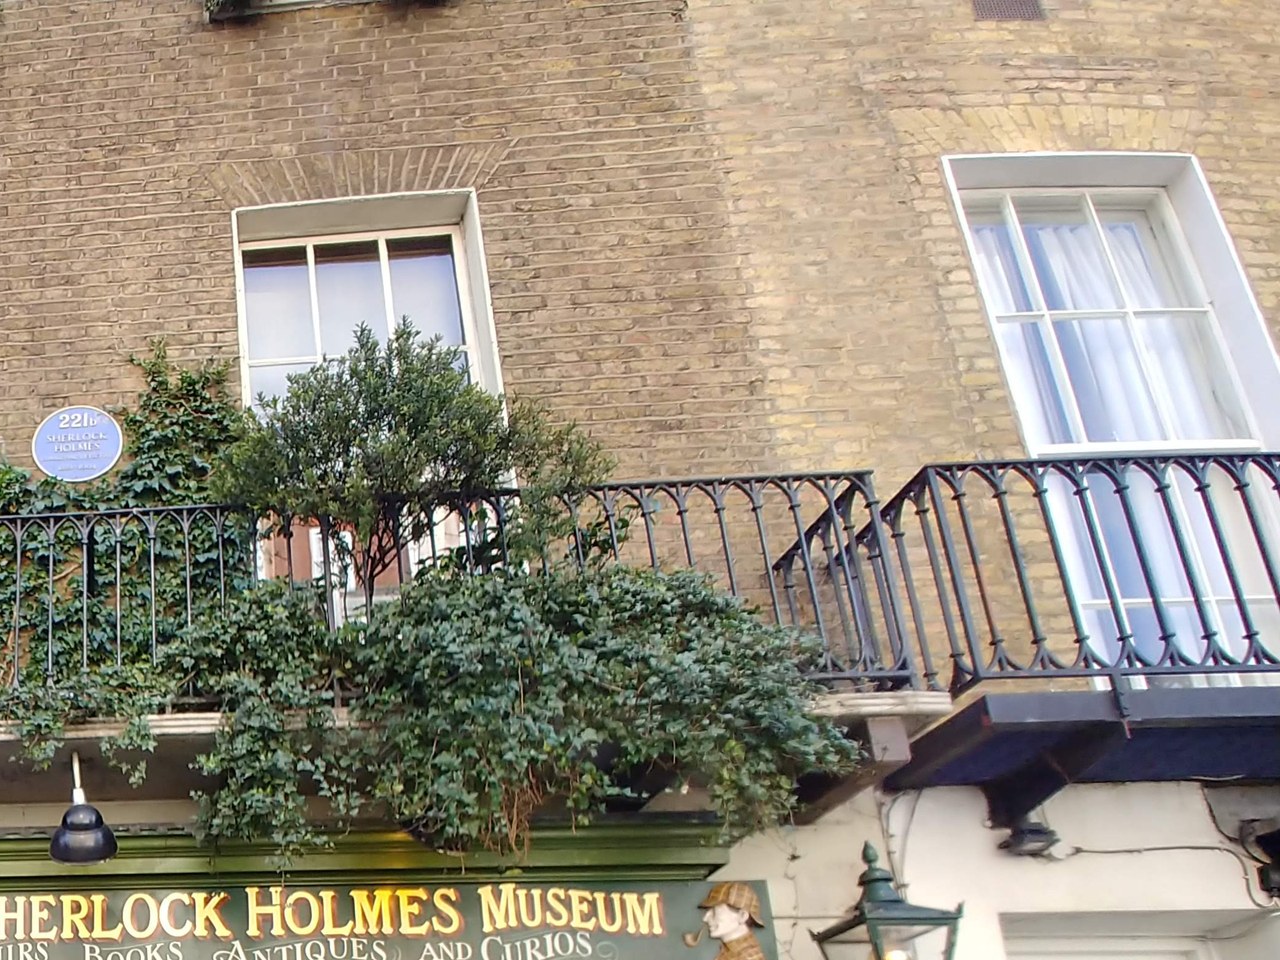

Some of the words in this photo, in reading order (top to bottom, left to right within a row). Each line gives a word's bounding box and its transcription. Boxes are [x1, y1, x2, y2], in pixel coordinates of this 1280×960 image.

[59, 412, 97, 429] 221b
[47, 432, 107, 442] SHERLOCK
[54, 442, 101, 452] HOLMES
[244, 886, 462, 937] HOLMES
[477, 883, 664, 935] MUSEUM
